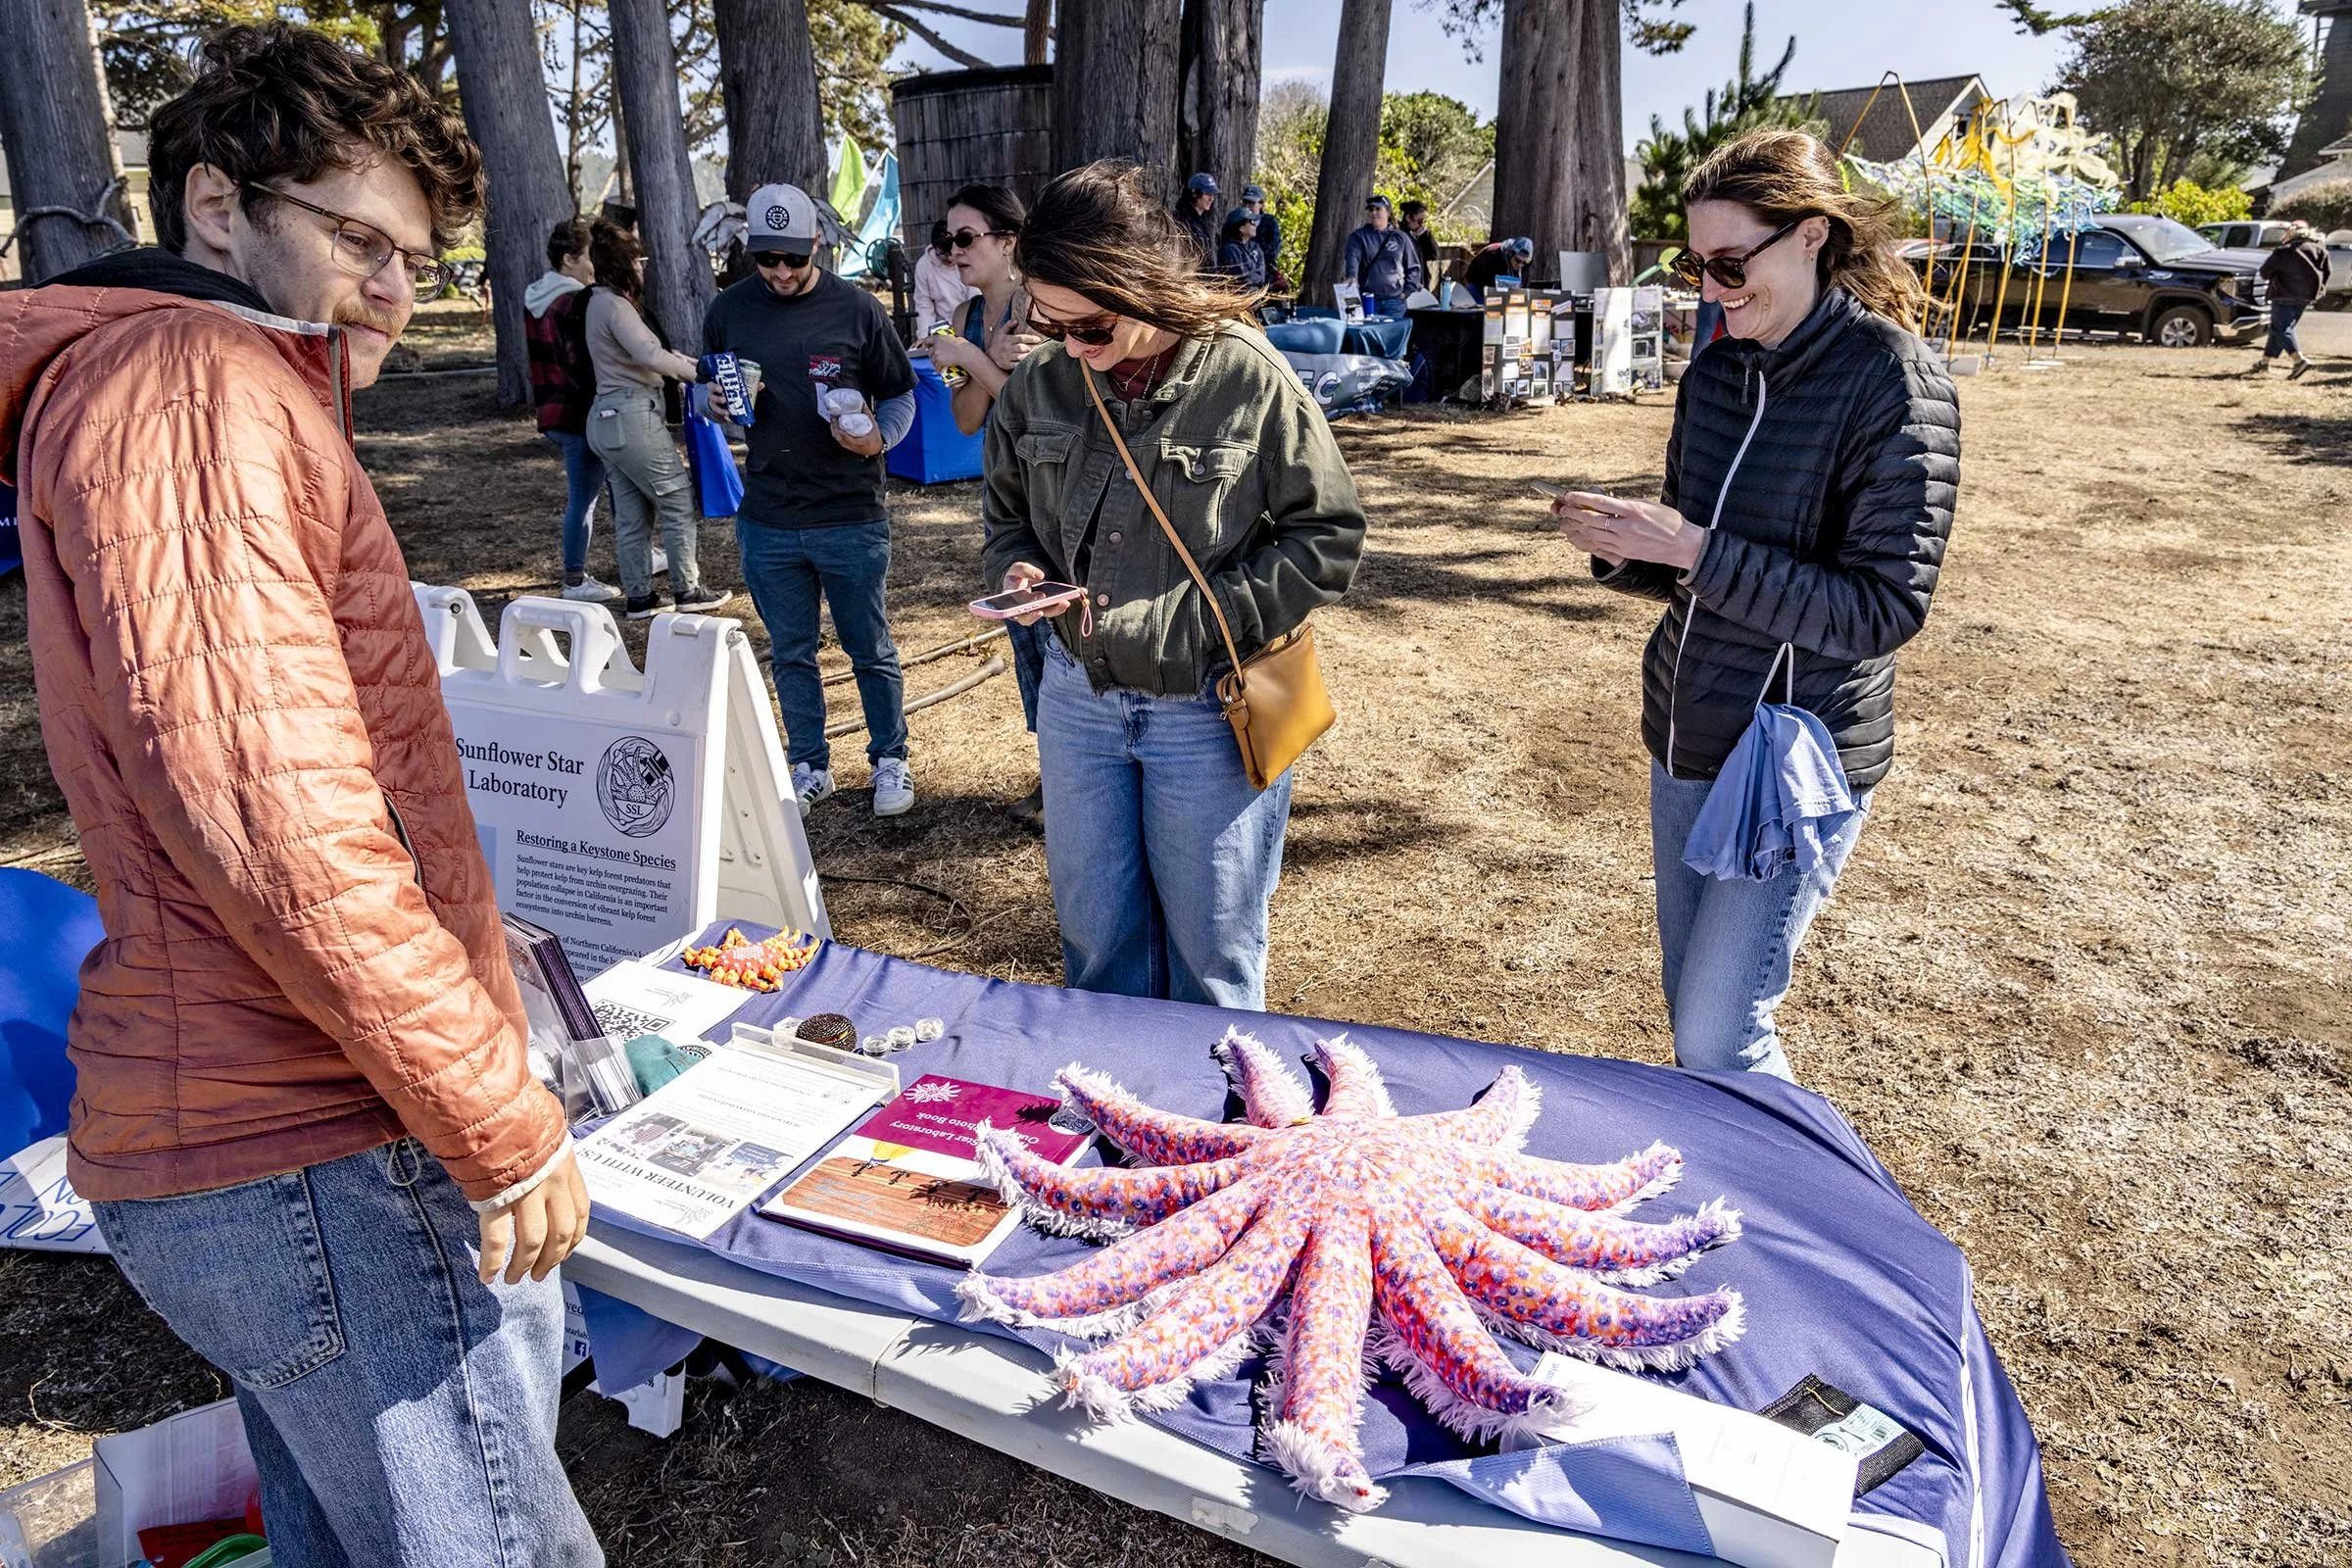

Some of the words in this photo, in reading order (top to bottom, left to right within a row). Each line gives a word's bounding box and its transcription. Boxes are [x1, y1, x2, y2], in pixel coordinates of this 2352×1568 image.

[456, 737, 543, 768] Sunflower
[547, 751, 584, 775] Star
[468, 769, 568, 809] Laboratory
[626, 803, 643, 815] SSL
[516, 829, 568, 853] Restoring
[570, 842, 577, 851] a
[580, 840, 630, 860] Keystone
[632, 849, 676, 868] Species
[516, 854, 548, 866] Sunflower
[576, 864, 588, 875] key
[589, 866, 603, 878] kelp
[604, 869, 622, 880] forest
[623, 874, 657, 887] predators
[657, 879, 670, 889] that
[516, 864, 530, 876] help
[531, 869, 554, 880] protect
[554, 872, 567, 883] kelp
[568, 875, 585, 885] from
[585, 879, 607, 890] urchin
[649, 890, 668, 901] Their
[515, 888, 534, 899] factor
[542, 894, 553, 903] the
[553, 900, 588, 909] conversion
[588, 903, 596, 911] of
[597, 905, 620, 916] vibrant
[621, 908, 636, 921] kelp
[636, 911, 656, 923] forest
[516, 878, 549, 891] population
[550, 884, 575, 896] collapse
[576, 888, 583, 897] in
[584, 890, 616, 903] California
[617, 896, 623, 905] is
[634, 899, 667, 912] important
[515, 901, 550, 913] ecosystems
[551, 906, 564, 916] into
[564, 910, 586, 921] urchin
[570, 937, 600, 950] Northern
[601, 943, 638, 957] California's
[590, 952, 597, 961] in
[598, 955, 610, 964] the
[916, 1111, 948, 1124] Book
[890, 1120, 956, 1141] Laboratory
[955, 1135, 978, 1147] Star
[576, 1148, 602, 1161] US!
[601, 1156, 644, 1176] WITH
[645, 1171, 735, 1208] VOLUNTEER
